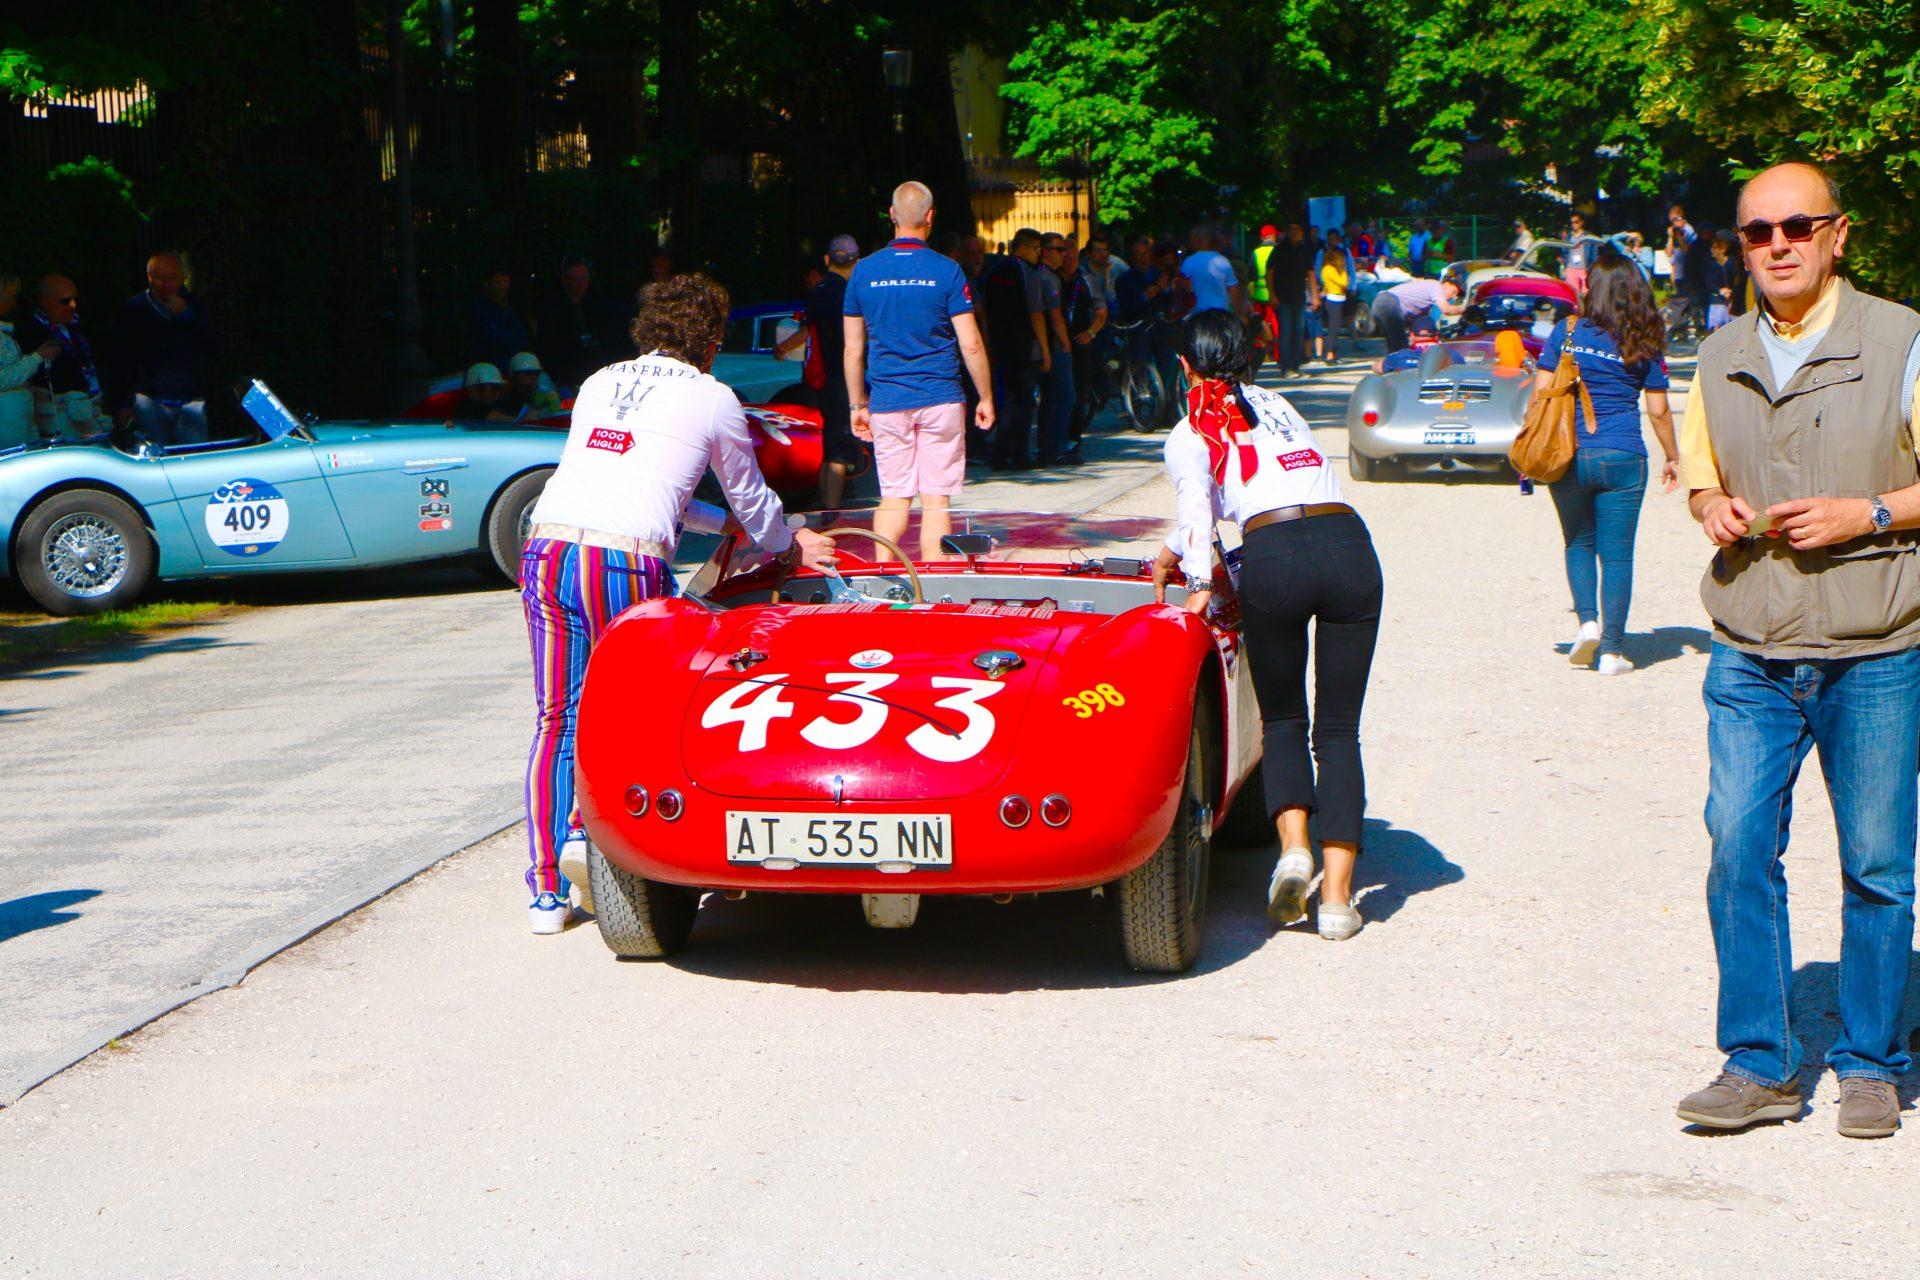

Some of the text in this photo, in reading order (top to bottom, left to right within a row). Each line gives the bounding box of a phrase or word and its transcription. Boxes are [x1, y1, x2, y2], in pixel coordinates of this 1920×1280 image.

[870, 279, 937, 288] PORSCHE
[596, 430, 626, 441] 1000
[588, 439, 624, 451] MIGLIA
[1282, 451, 1311, 462] 1000
[1285, 458, 1319, 470] MIGLIA
[224, 504, 271, 532] 409
[1062, 683, 1126, 719] 398
[701, 672, 1006, 762] 433
[736, 817, 944, 860] AT 535 NN
